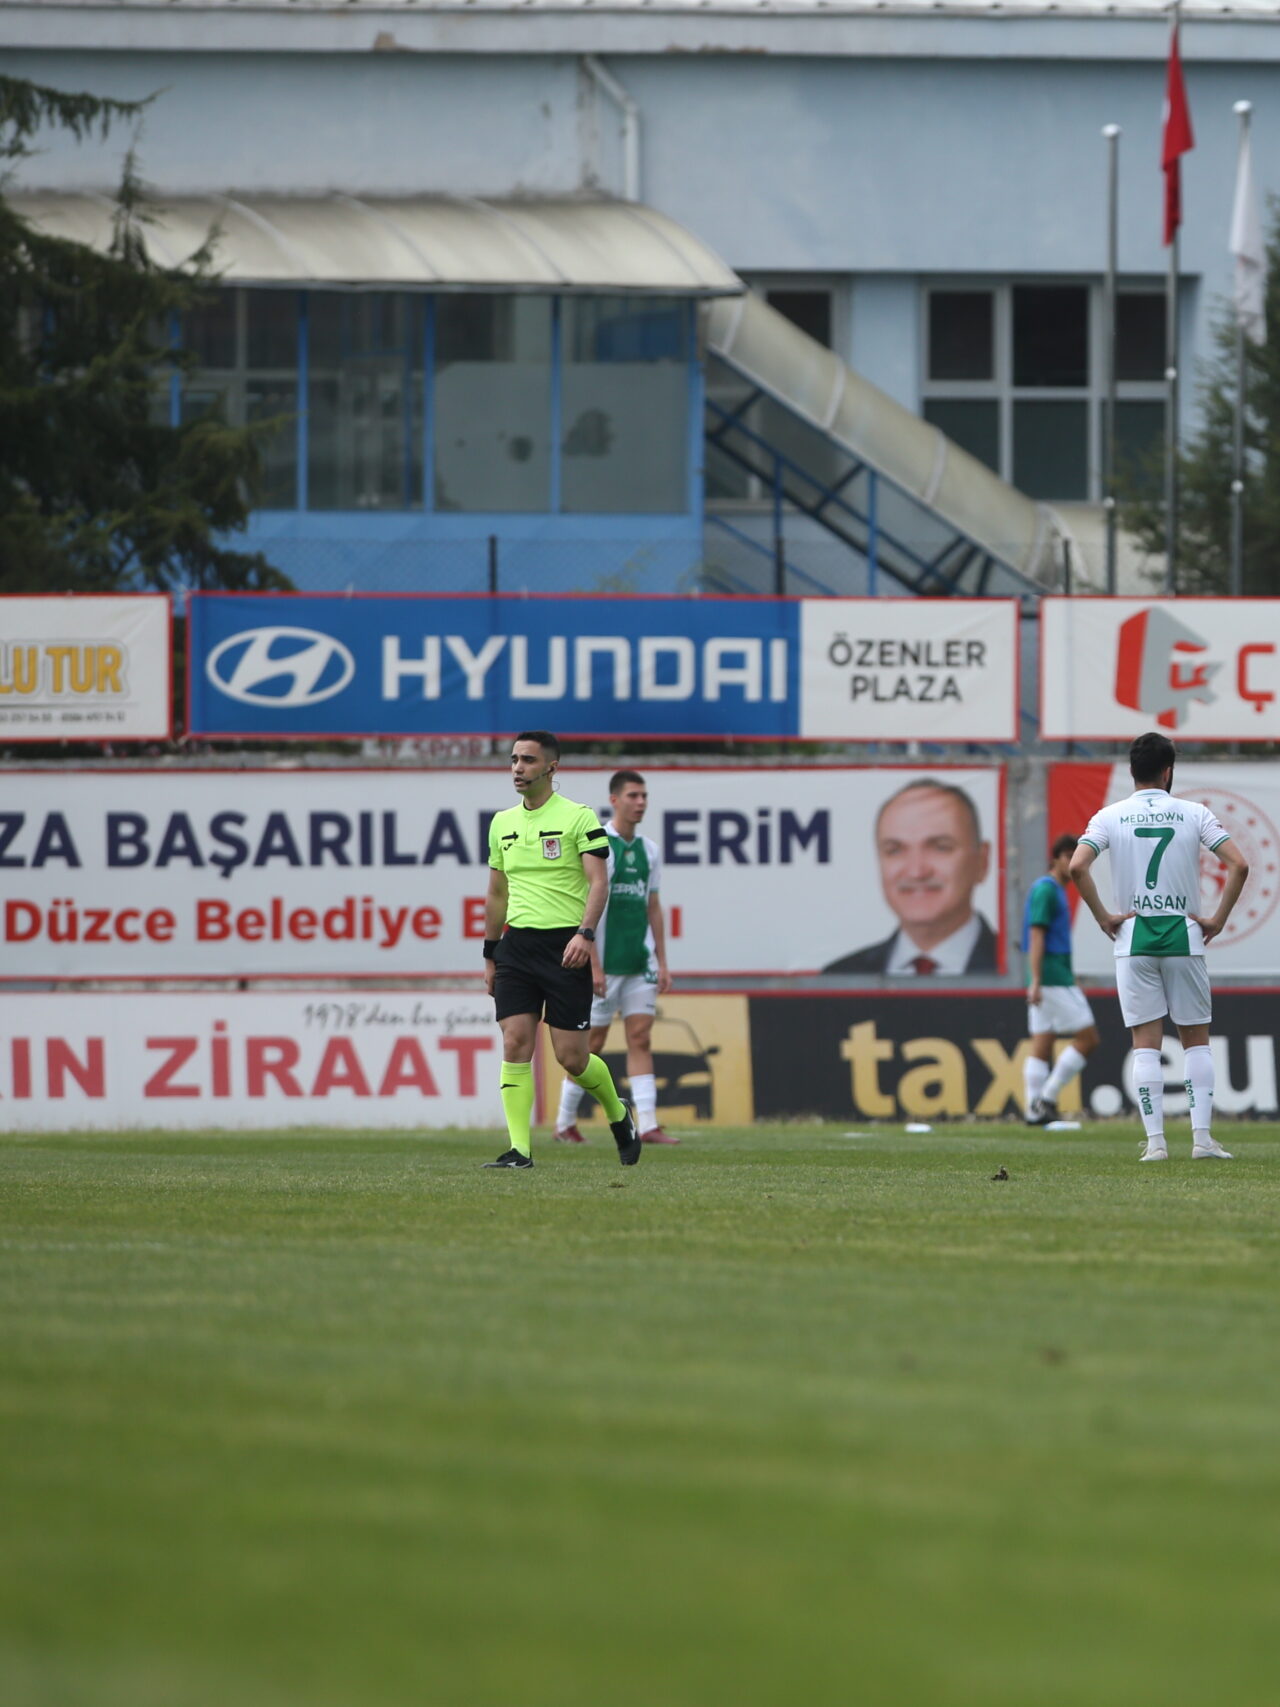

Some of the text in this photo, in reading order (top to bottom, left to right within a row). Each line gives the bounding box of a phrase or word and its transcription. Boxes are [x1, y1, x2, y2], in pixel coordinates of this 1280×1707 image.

[46, 645, 122, 694] TUR
[383, 635, 788, 701] HYUNDAI
[829, 632, 987, 668] ÖZENLER
[851, 675, 962, 703] PLAZA
[1134, 827, 1175, 890] 7
[4, 899, 175, 943] Düzce
[196, 896, 443, 948] Belediye
[1134, 894, 1187, 910] HASAN
[143, 1018, 495, 1099] ZİRAAT
[1139, 1087, 1153, 1115] aroma
